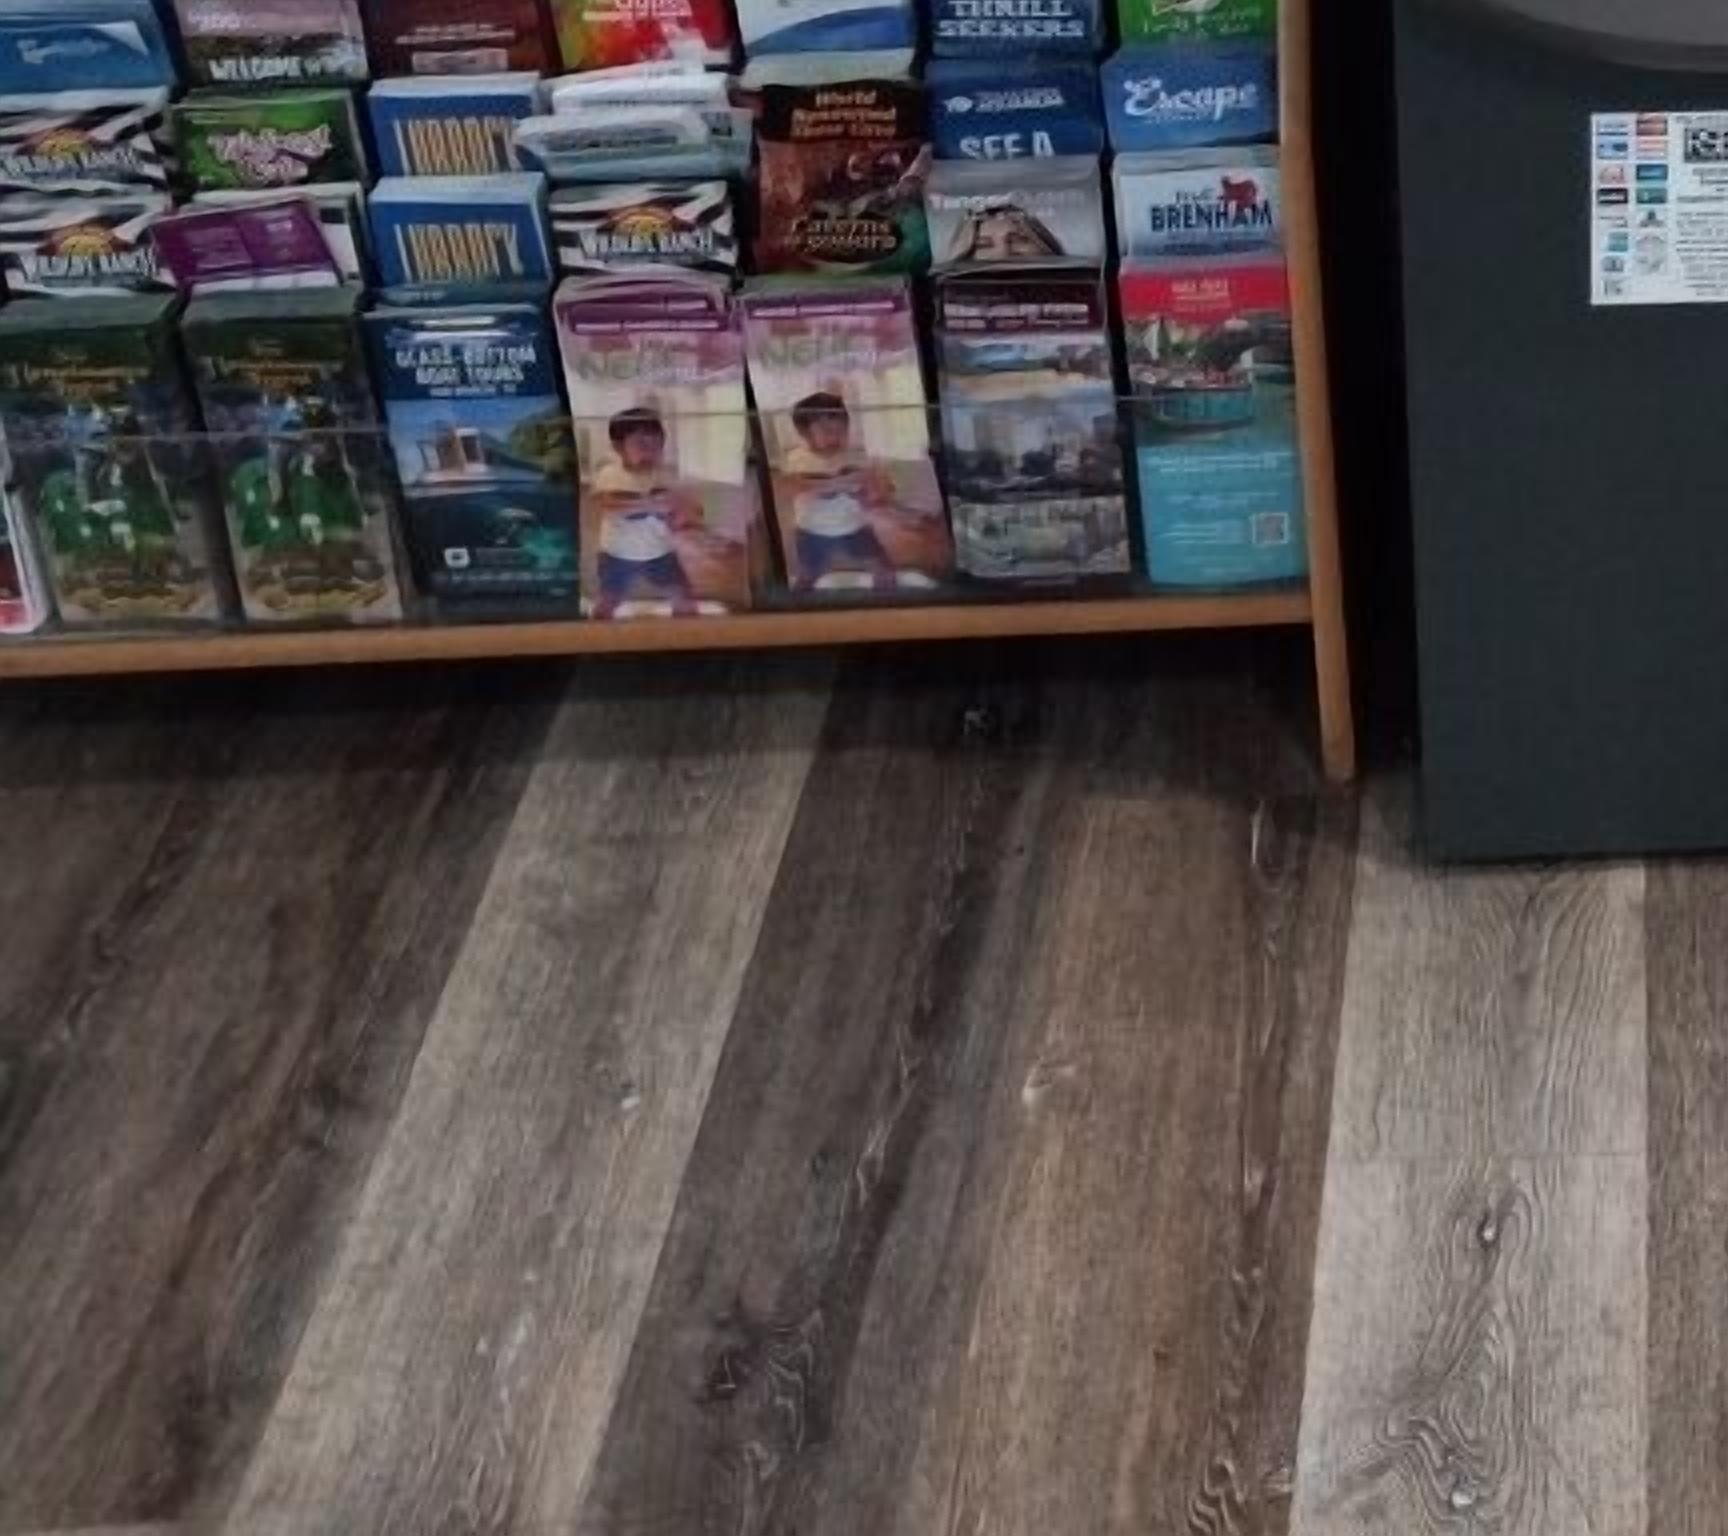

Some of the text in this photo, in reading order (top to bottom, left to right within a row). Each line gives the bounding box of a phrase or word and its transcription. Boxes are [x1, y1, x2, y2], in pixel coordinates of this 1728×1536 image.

[947, 0, 1072, 17] THRILL
[937, 19, 1085, 37] SEEKERS
[1123, 75, 1257, 121] Escape
[1151, 200, 1273, 233] BRENHAM
